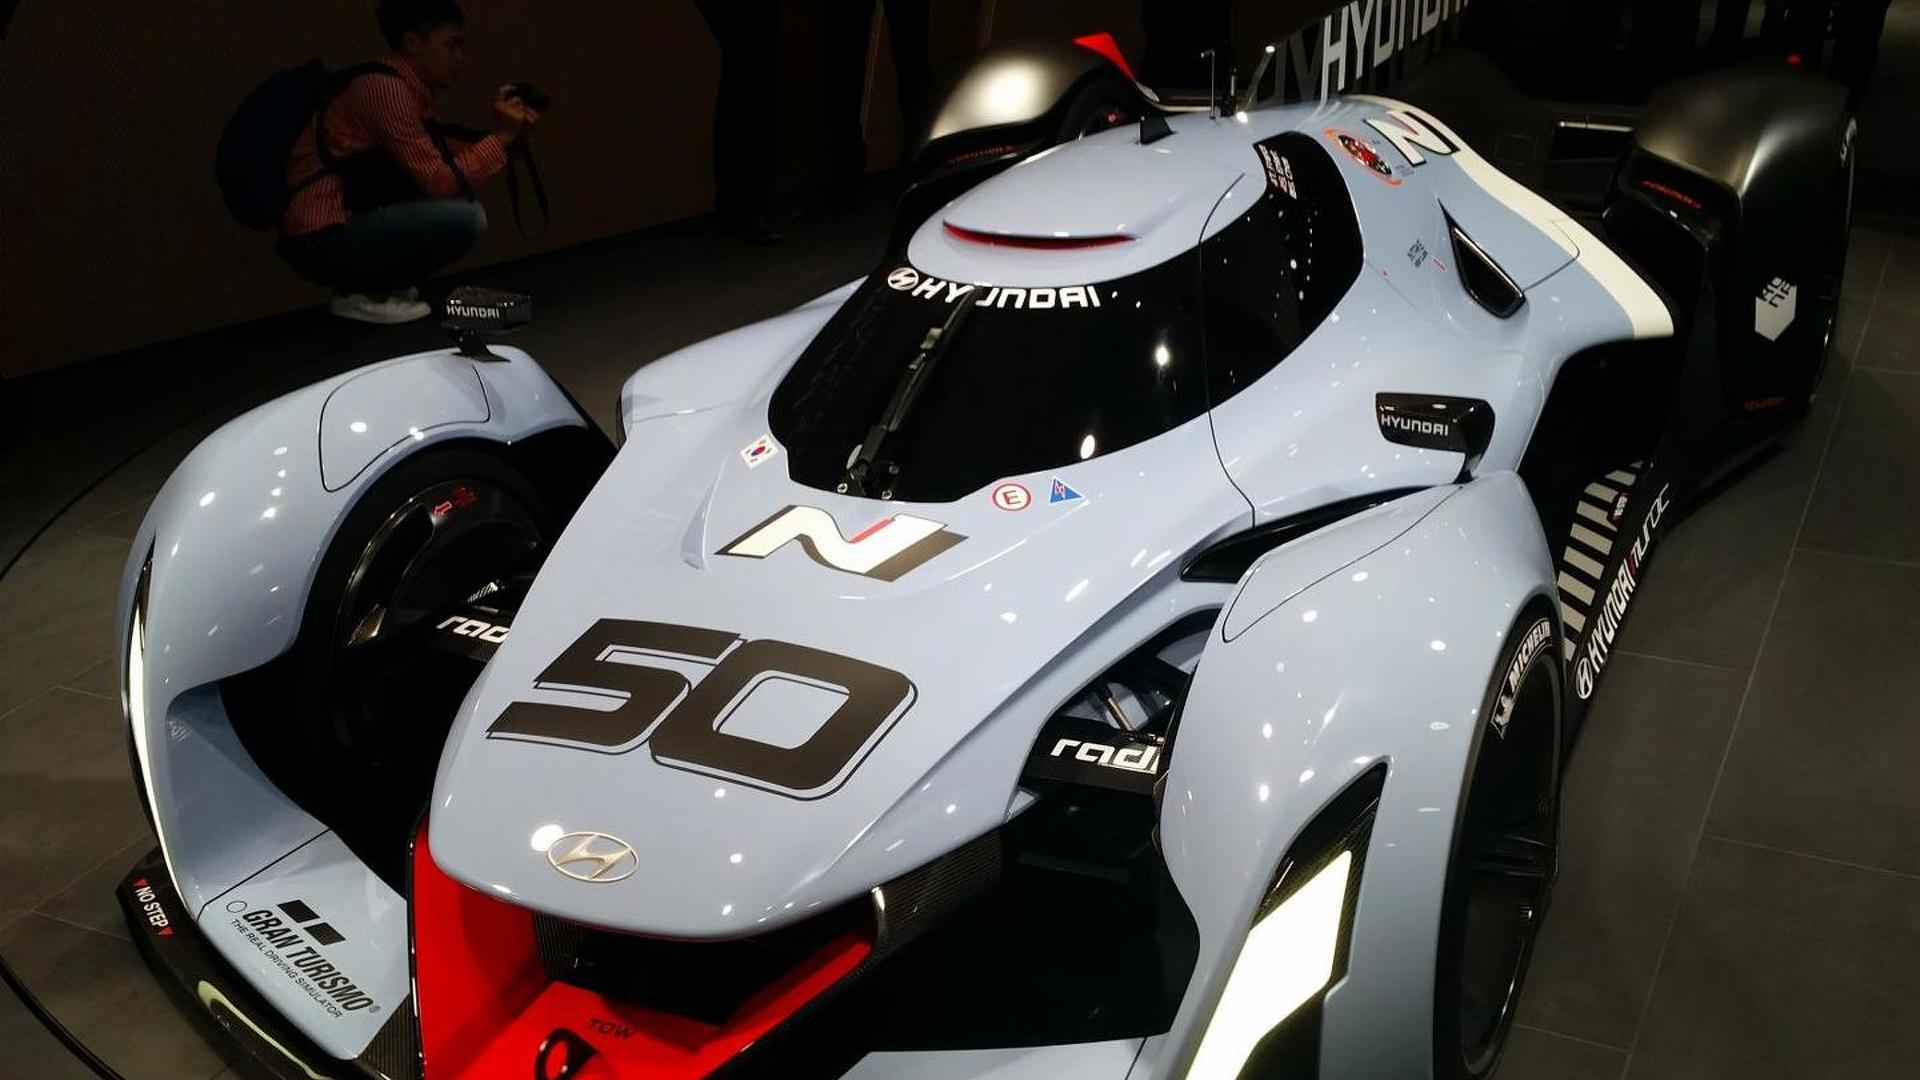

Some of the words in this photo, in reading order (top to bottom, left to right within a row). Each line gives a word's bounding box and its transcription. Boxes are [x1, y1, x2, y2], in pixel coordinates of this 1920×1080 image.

[912, 277, 1101, 309] HYUNDAI
[446, 304, 500, 319] HYUNDAI
[1380, 413, 1449, 437] HYUNDAI
[1588, 558, 1637, 673] HYUNDAI
[485, 618, 918, 801] 50
[134, 886, 156, 902] NO
[143, 902, 169, 927] STEP
[242, 910, 304, 949] GRAN
[231, 918, 250, 935] THE
[246, 931, 267, 951] REAL
[263, 949, 299, 980] DRIVING
[294, 977, 343, 1019] SIMULATOR
